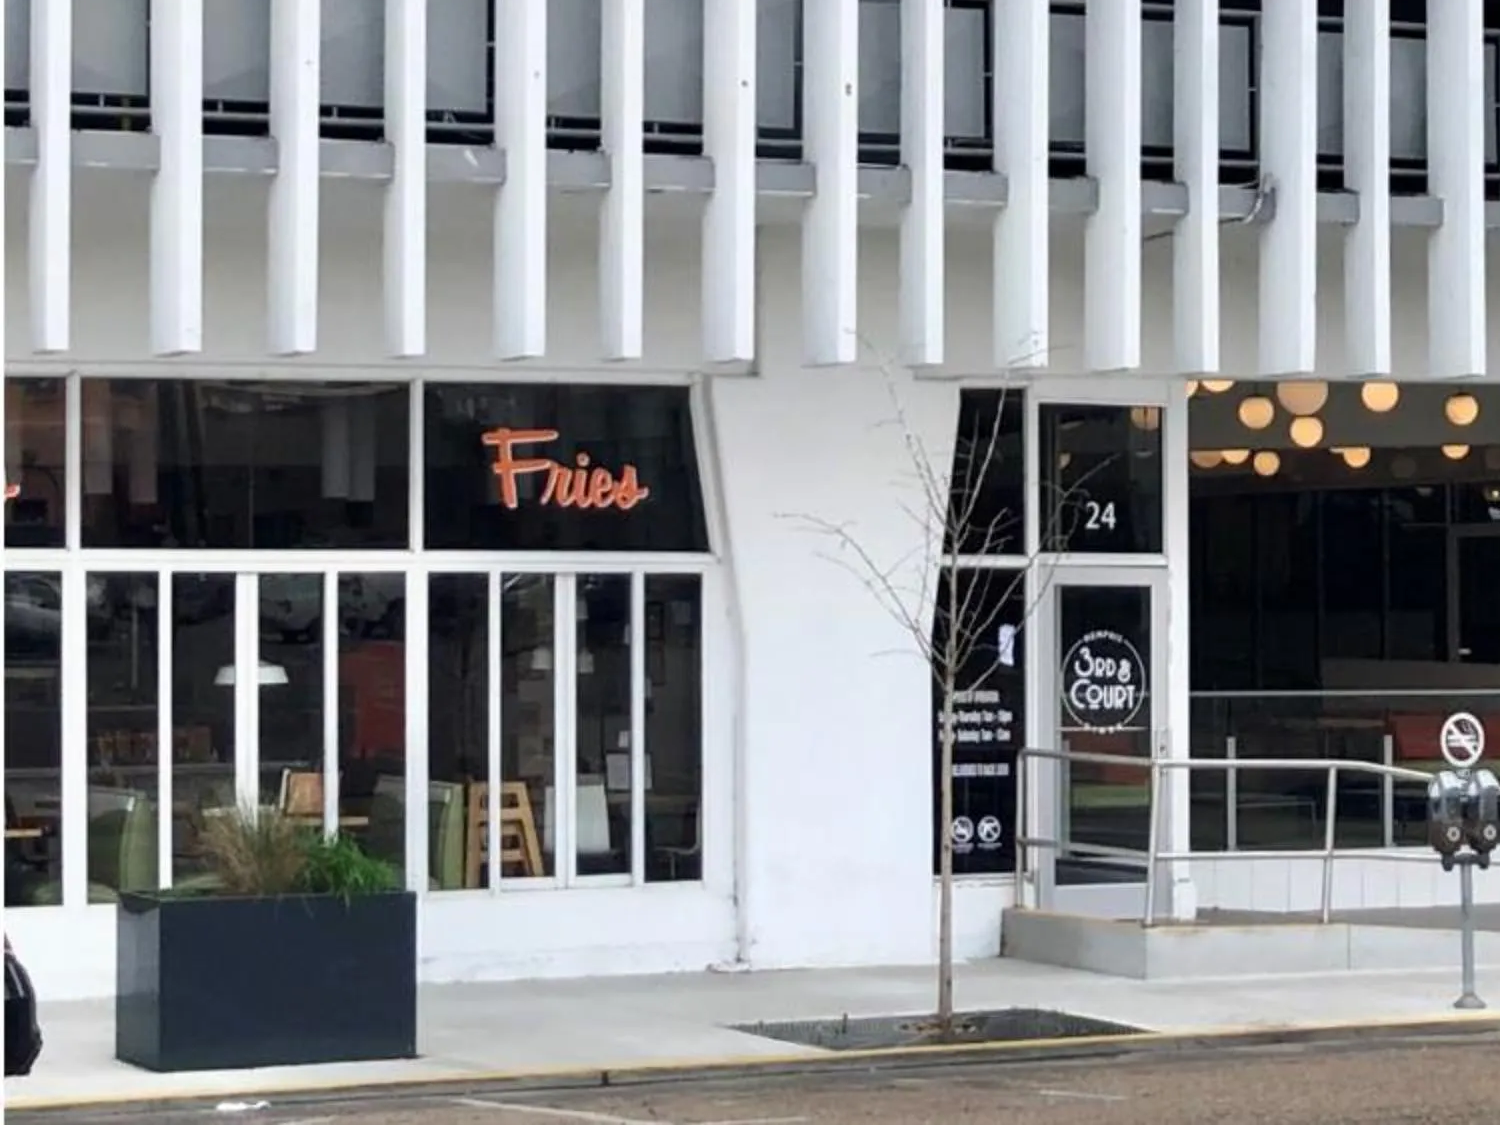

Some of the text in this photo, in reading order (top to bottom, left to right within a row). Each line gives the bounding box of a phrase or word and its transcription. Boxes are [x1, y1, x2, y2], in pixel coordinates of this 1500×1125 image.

[481, 427, 650, 510] Fries
[1085, 500, 1117, 531] 24
[1074, 646, 1117, 678] 3RD
[1070, 678, 1135, 709] COURT
